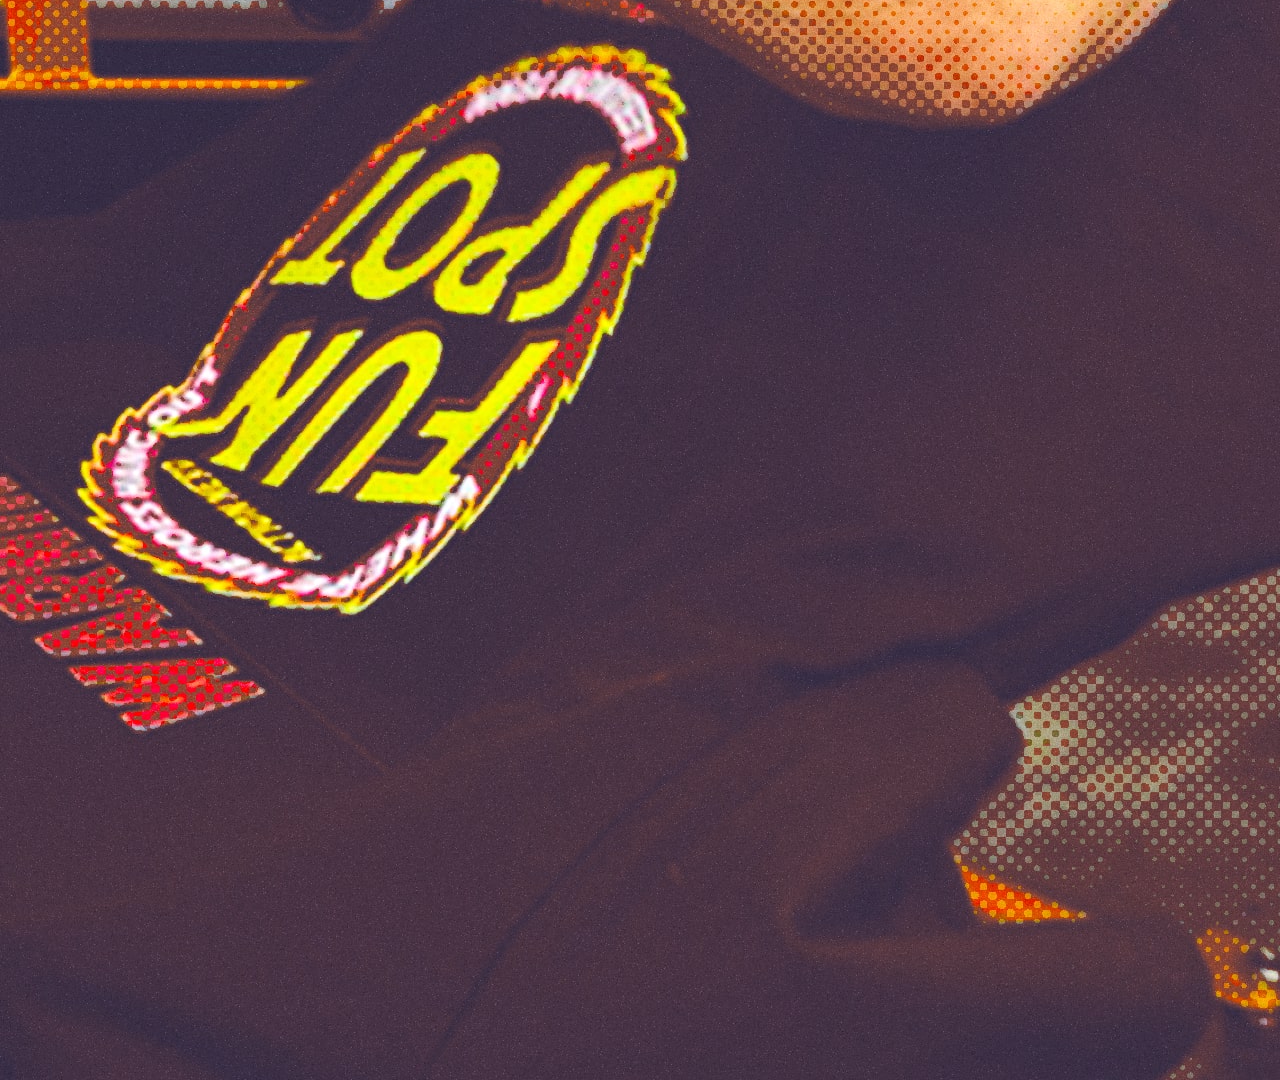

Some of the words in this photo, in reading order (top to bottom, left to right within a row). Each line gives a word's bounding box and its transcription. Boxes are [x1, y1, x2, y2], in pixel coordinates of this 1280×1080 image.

[271, 149, 678, 321] SPOT
[148, 354, 221, 427] OUT
[156, 329, 559, 505] FUN
[118, 499, 294, 586] HEROES
[276, 474, 481, 599] WHERE
